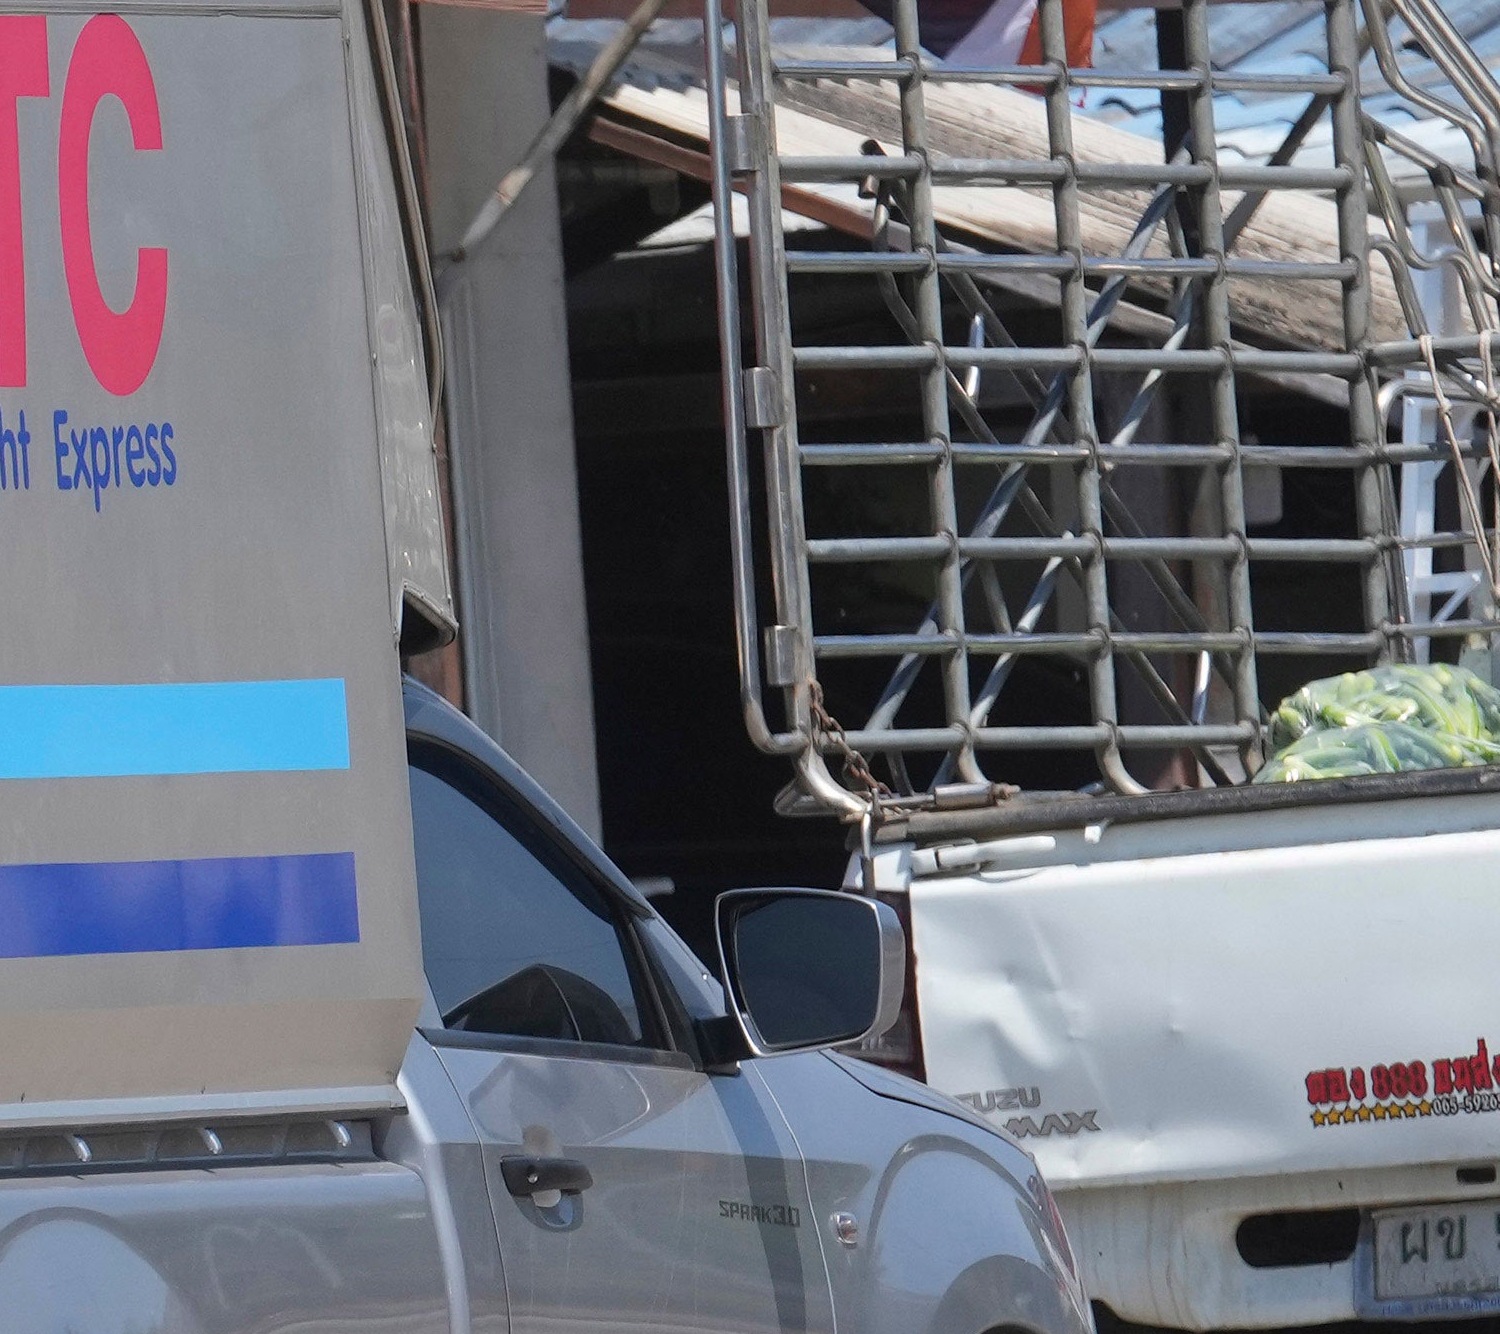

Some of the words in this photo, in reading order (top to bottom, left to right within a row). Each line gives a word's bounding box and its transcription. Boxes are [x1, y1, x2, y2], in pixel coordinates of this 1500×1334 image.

[53, 408, 178, 513] Express
[1370, 1058, 1429, 1101] 888
[954, 1086, 1042, 1113] UZU
[1003, 1109, 1102, 1138] MAX
